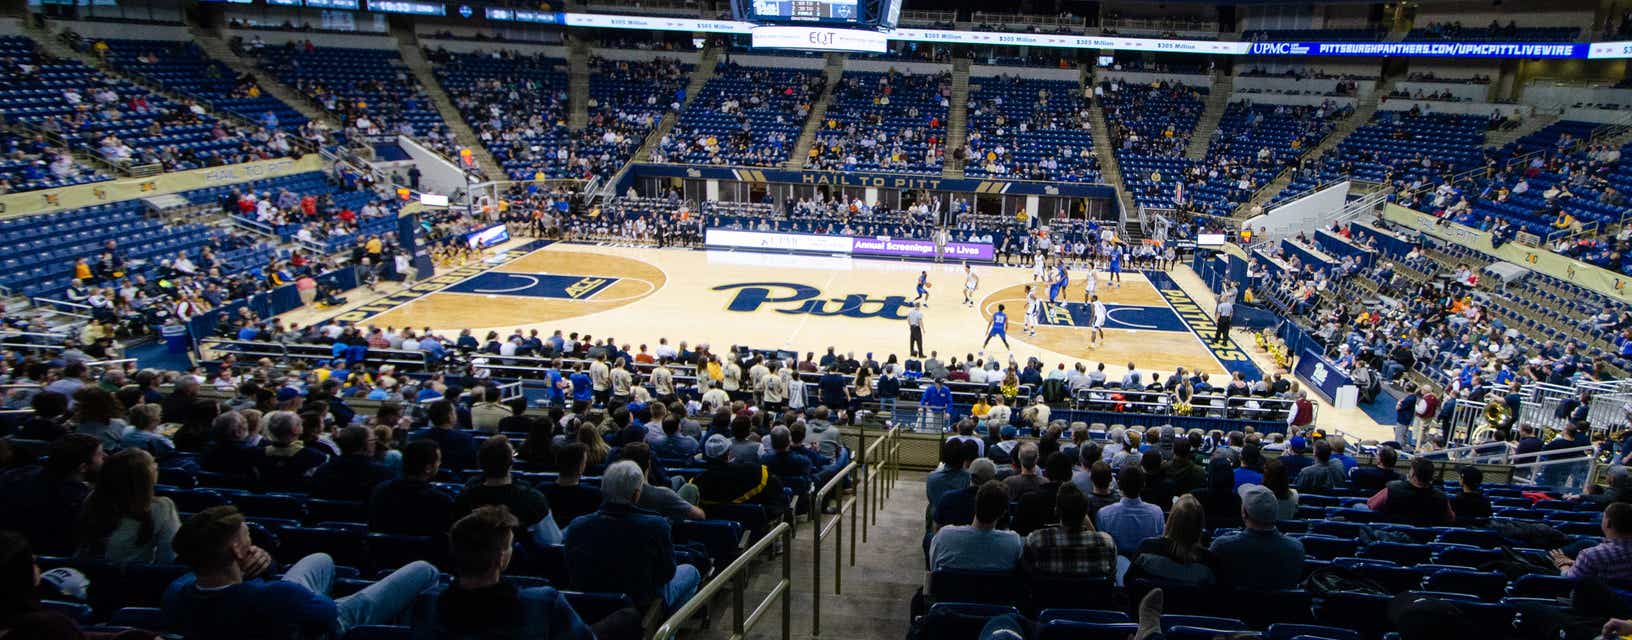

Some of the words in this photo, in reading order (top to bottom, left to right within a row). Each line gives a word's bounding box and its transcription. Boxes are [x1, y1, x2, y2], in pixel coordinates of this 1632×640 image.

[809, 31, 836, 45] EQT
[1253, 43, 1290, 54] UPMC
[1320, 43, 1573, 56] PITTSBURGHPANTHERS.COM/UPMCPITTLIVEWIRE
[802, 174, 850, 185] HAIL
[858, 176, 885, 187] TO
[894, 178, 941, 190] PITT
[854, 241, 885, 249] Annual
[886, 242, 933, 253] Screenings
[956, 246, 980, 255] Lives
[565, 277, 603, 297] ACC
[710, 281, 914, 321] Pitt
